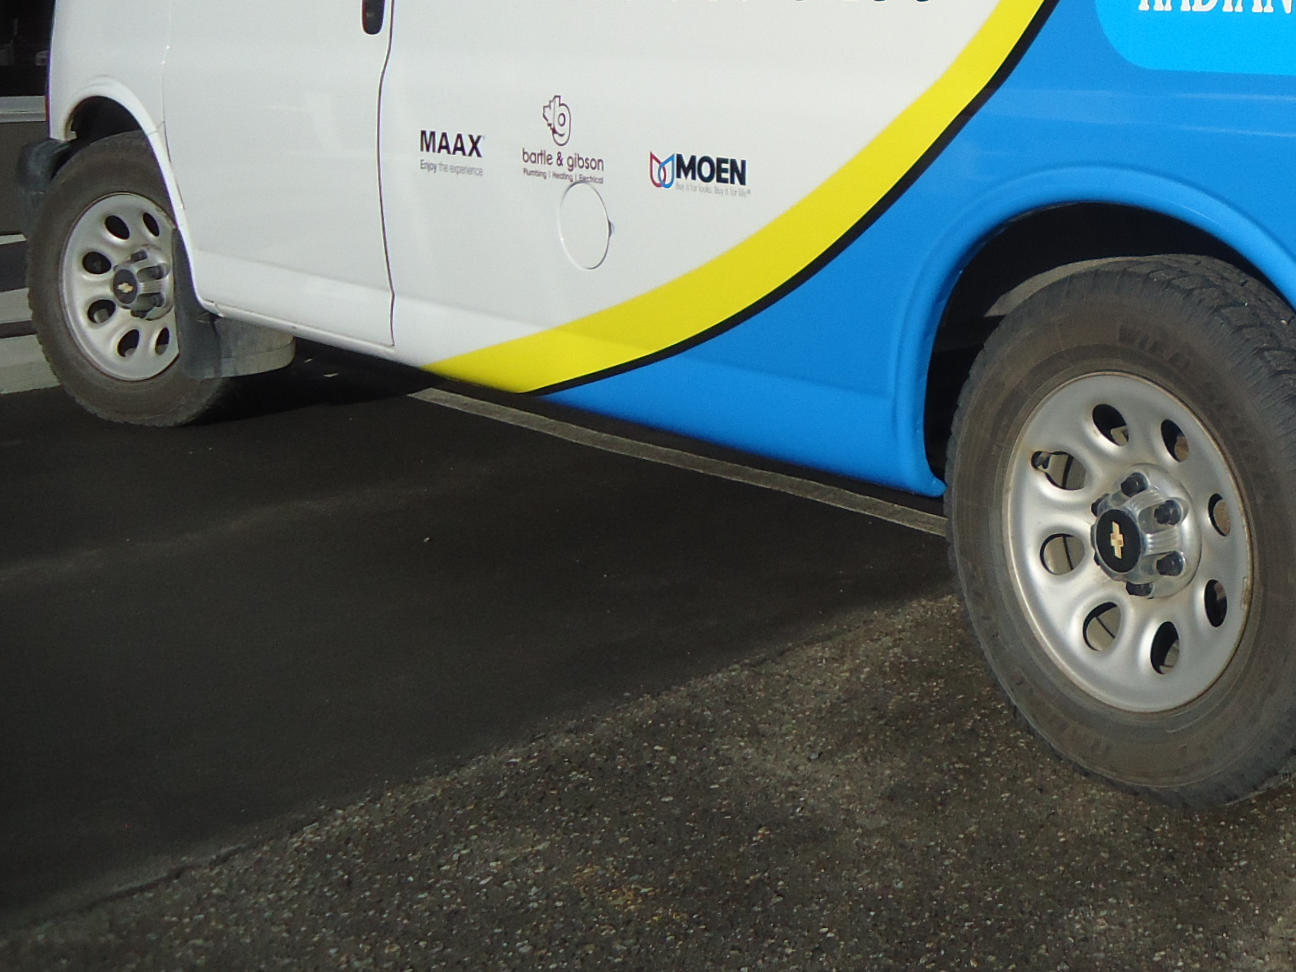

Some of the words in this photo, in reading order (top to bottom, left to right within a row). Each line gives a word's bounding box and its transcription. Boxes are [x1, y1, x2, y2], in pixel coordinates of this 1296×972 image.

[420, 130, 483, 158] MAAX
[420, 159, 437, 173] Enjoy
[522, 148, 553, 166] bartle
[556, 151, 564, 166] &
[567, 153, 605, 172] gibson
[676, 153, 746, 186] MOEN
